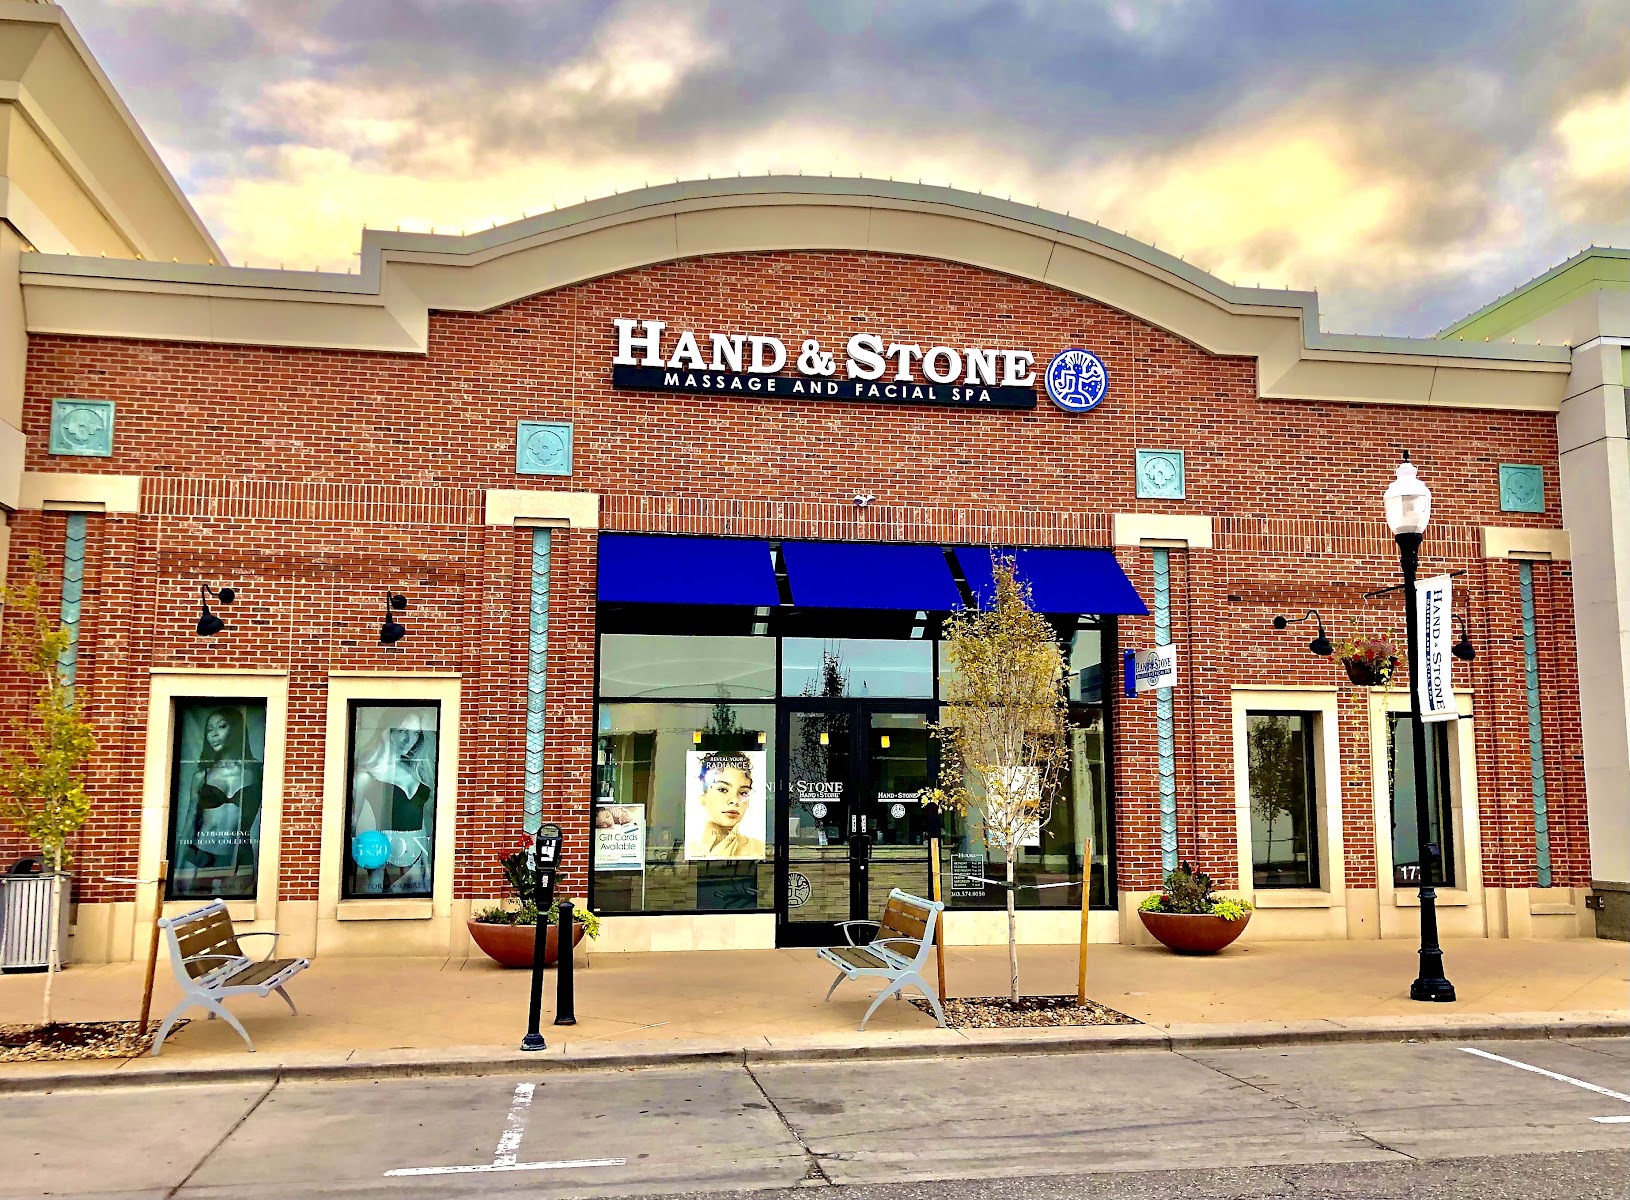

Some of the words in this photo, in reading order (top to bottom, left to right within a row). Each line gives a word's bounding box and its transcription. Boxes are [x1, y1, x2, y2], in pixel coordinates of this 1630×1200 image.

[613, 318, 787, 374] HAND
[797, 338, 836, 376] &
[847, 333, 1037, 387] STONE
[664, 372, 776, 391] MASSAGE
[793, 380, 839, 395] AND
[855, 384, 937, 400] FACIAL
[952, 388, 991, 402] SPA
[1432, 589, 1443, 639] HAND
[1433, 652, 1446, 711] STONE
[706, 761, 748, 769] RADIANCE
[796, 781, 843, 793] STONE
[599, 833, 613, 841] Gift
[614, 833, 638, 841] Cards
